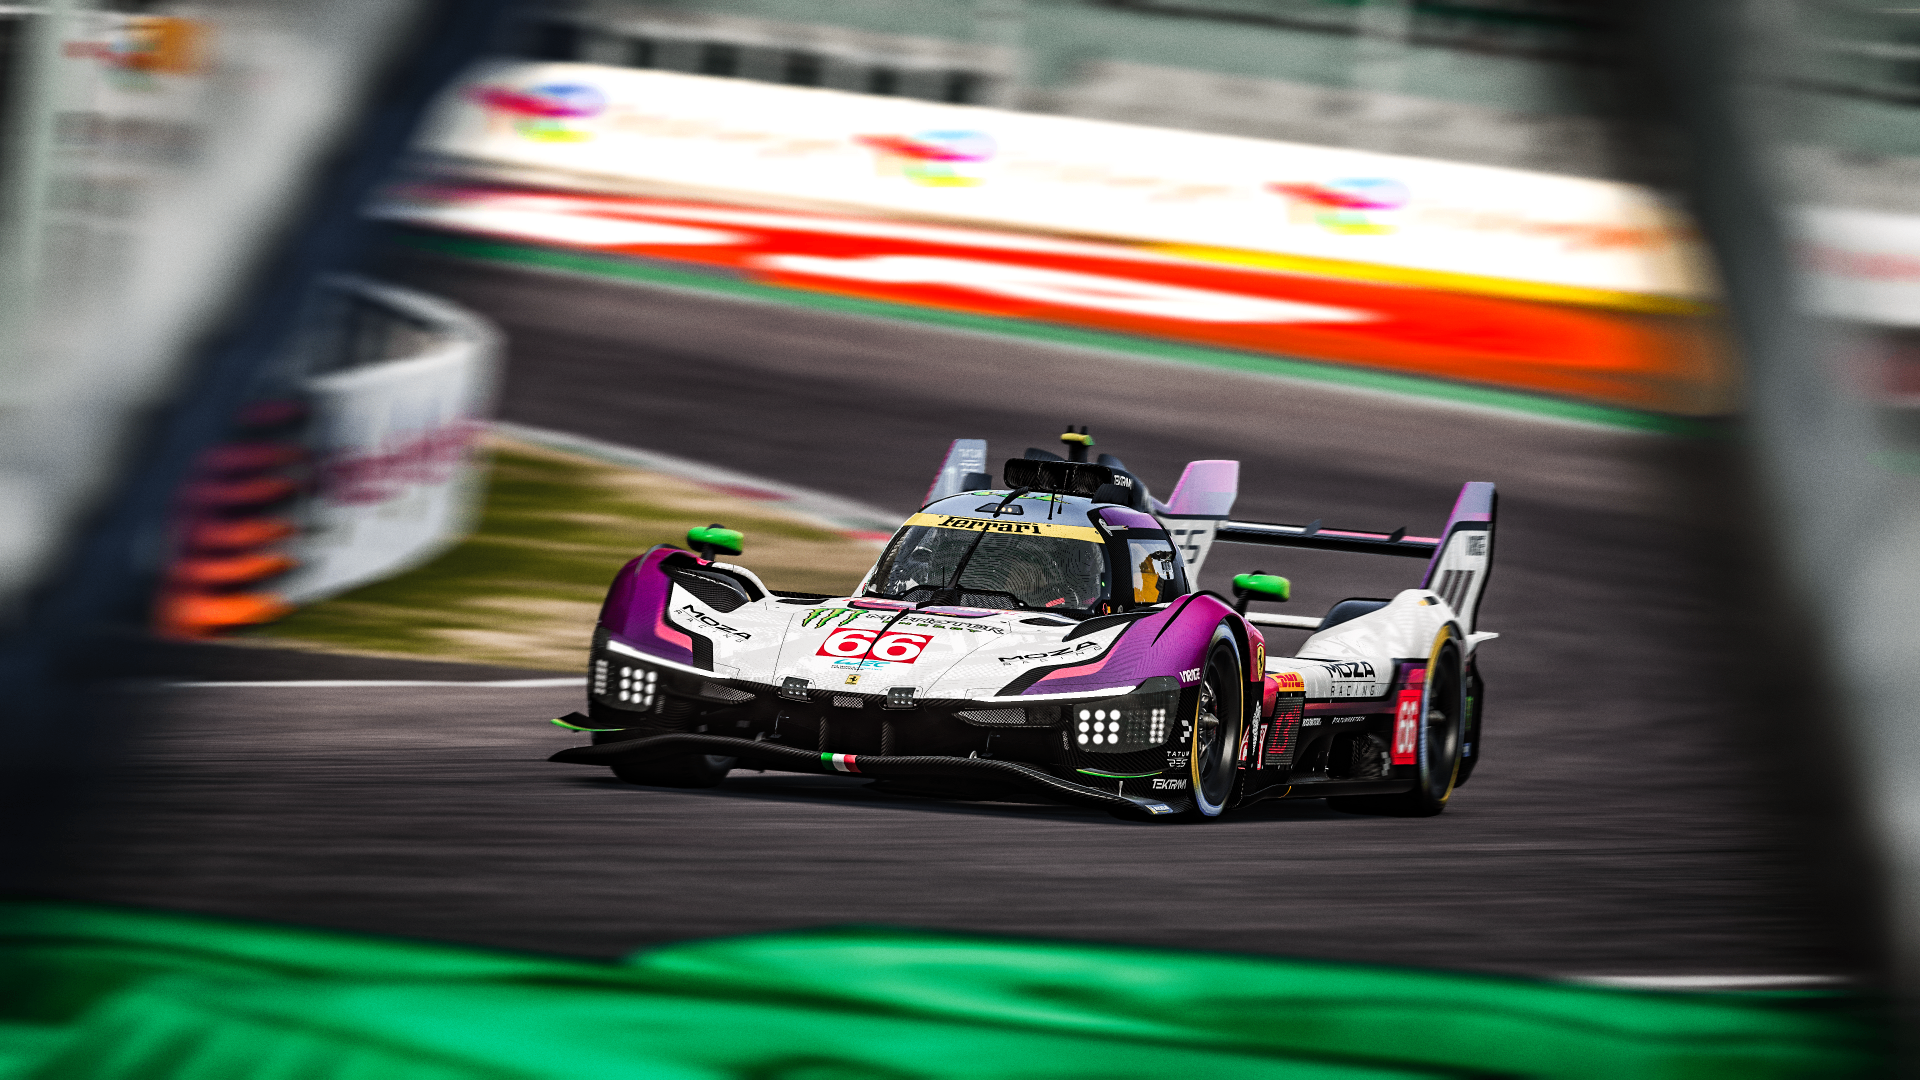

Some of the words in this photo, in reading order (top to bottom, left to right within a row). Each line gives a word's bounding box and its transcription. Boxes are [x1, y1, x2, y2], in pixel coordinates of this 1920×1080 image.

[938, 515, 1041, 534] Ferrari
[682, 604, 752, 640] MOZA
[823, 629, 927, 662] 66
[998, 641, 1098, 662] MOZA
[1322, 661, 1376, 678] MOZA
[1331, 685, 1376, 696] RACING
